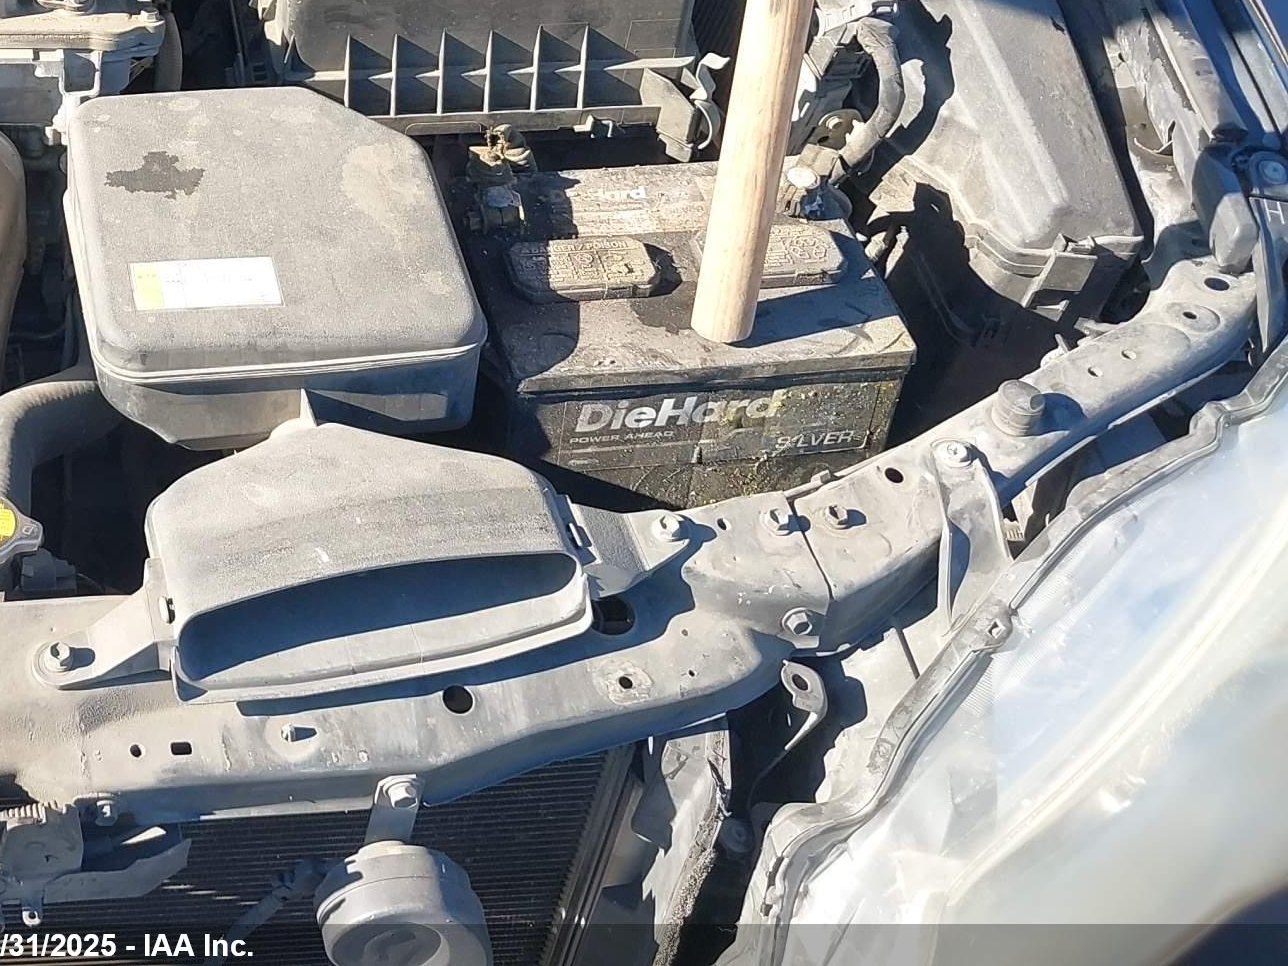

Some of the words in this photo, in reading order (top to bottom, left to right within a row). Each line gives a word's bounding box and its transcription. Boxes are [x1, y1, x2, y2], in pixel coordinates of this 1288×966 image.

[574, 389, 785, 433] DieHard
[569, 434, 620, 444] POWER
[624, 430, 674, 440] AHEAD
